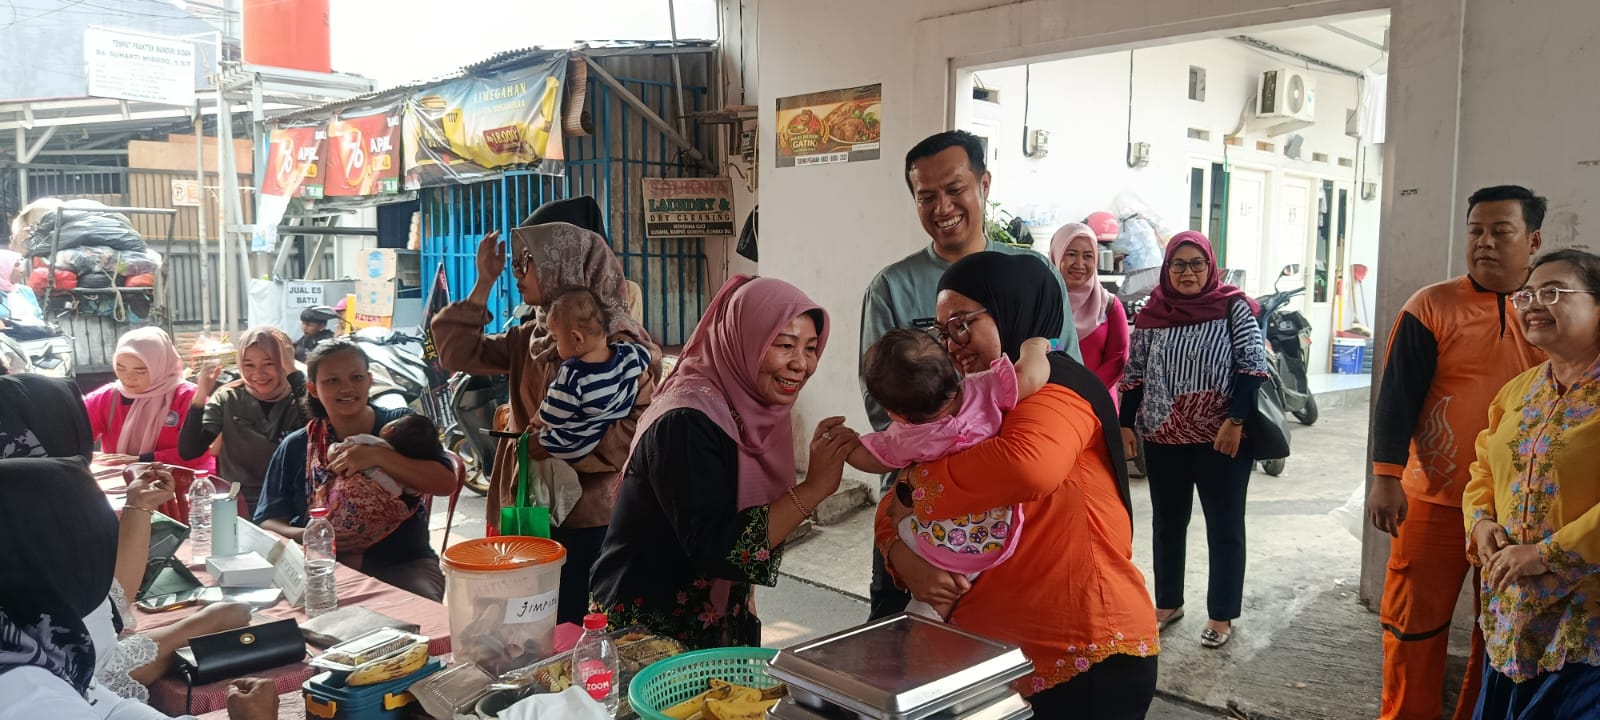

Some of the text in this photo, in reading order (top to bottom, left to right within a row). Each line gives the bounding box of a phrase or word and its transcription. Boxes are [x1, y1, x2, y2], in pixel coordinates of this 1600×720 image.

[109, 51, 140, 61] SUMARTI
[793, 139, 816, 149] GATIK
[648, 198, 730, 212] LAUNDRY &
[651, 214, 670, 222] DRY
[289, 286, 322, 294] JUAL ES
[296, 296, 318, 304] BATU
[586, 681, 609, 691] ZOOM
